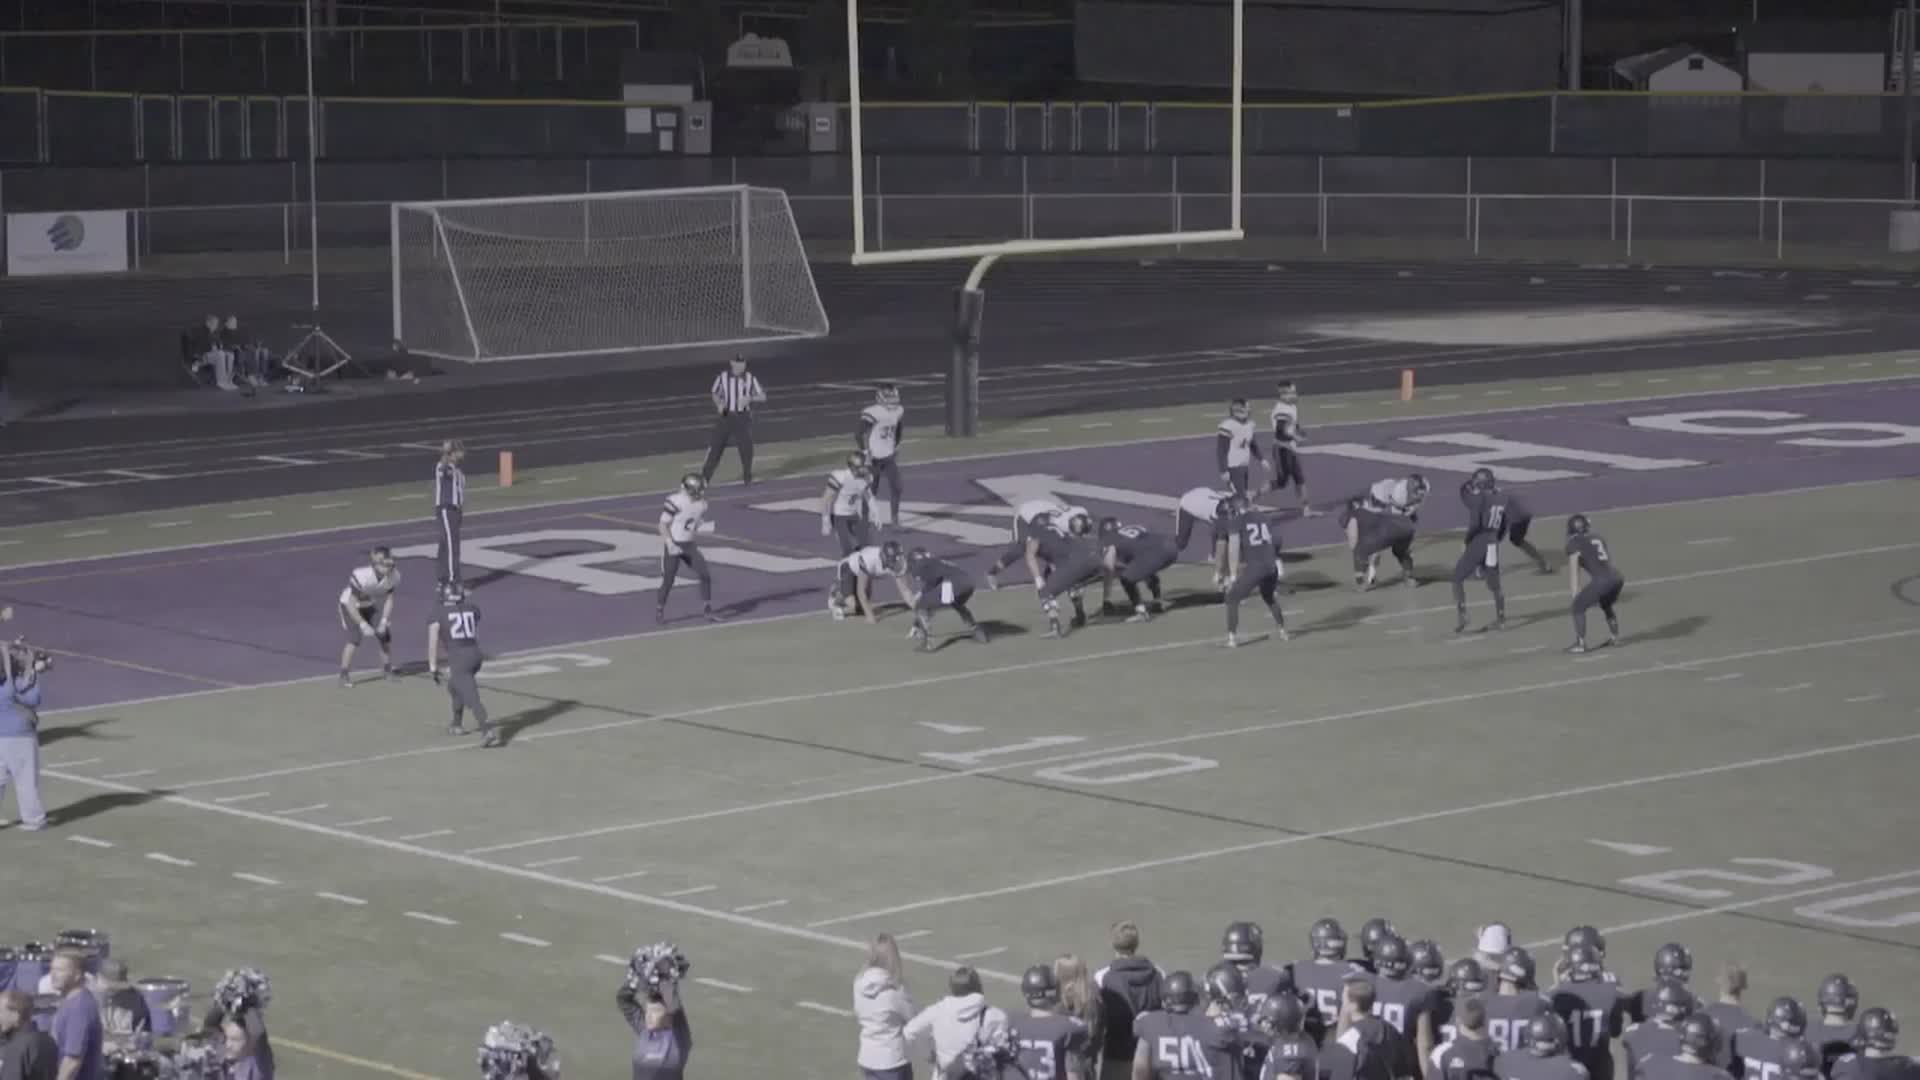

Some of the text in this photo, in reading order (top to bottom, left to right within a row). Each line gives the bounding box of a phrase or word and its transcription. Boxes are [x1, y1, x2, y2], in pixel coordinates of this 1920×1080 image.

[1591, 539, 1608, 561] 3
[448, 612, 475, 638] 20
[1568, 1009, 1603, 1048] 17
